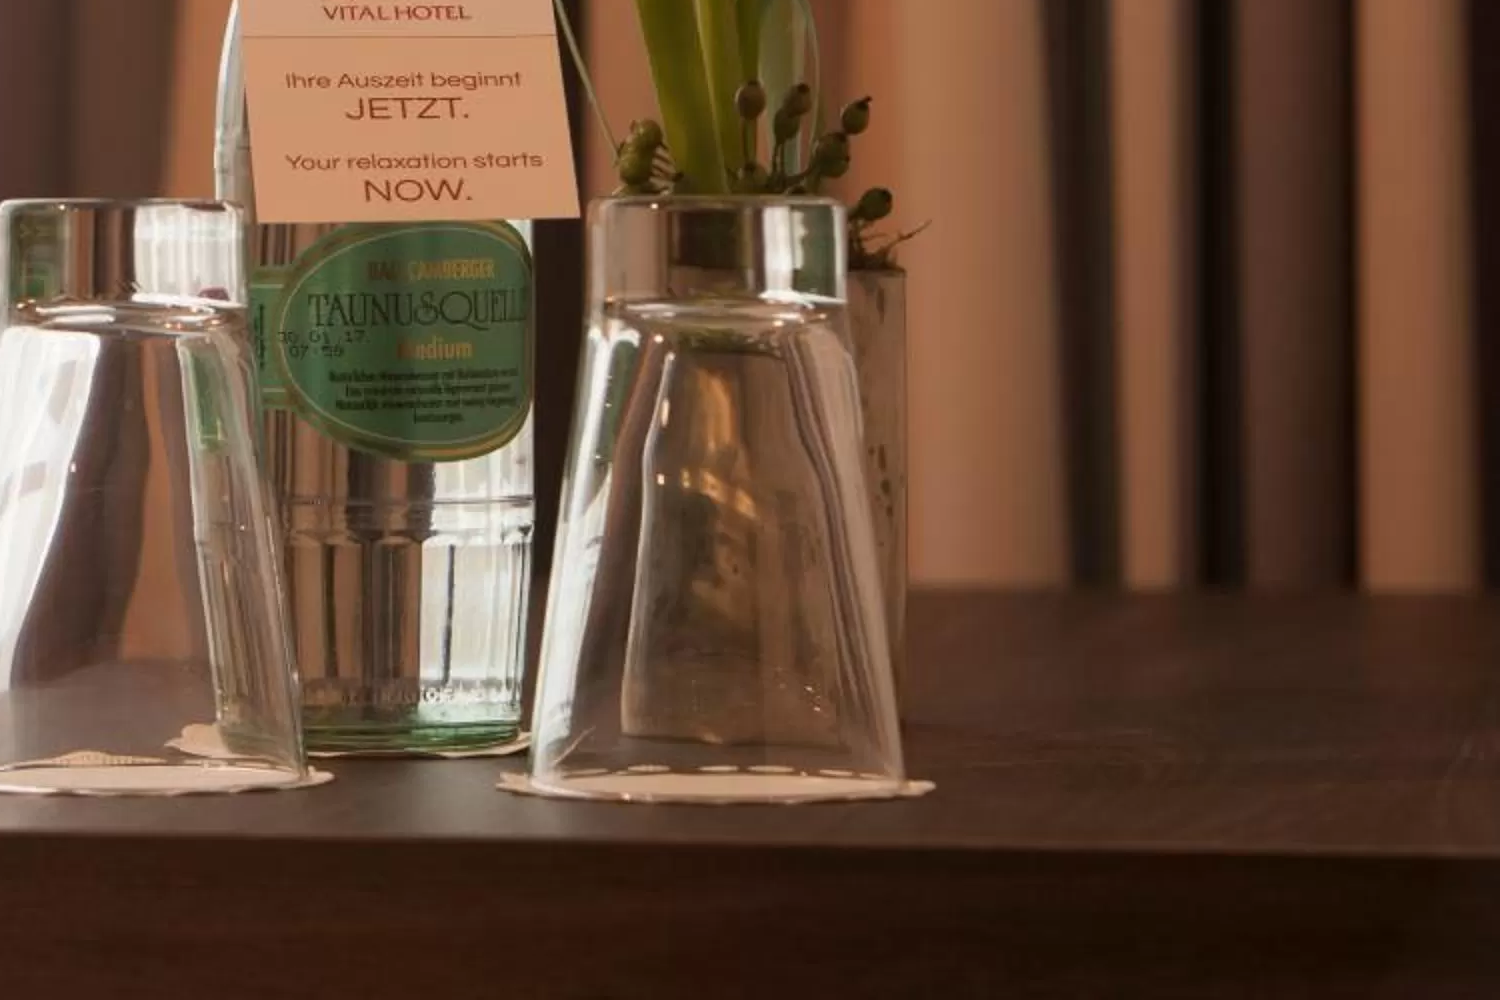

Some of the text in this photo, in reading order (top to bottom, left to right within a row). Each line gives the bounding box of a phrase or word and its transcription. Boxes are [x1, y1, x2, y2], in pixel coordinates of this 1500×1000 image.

[285, 72, 521, 92] Ihre Auszeit beginnt
[345, 97, 469, 121] JETZT.
[285, 152, 543, 171] Your relaxation starts
[364, 178, 473, 203] NOW.
